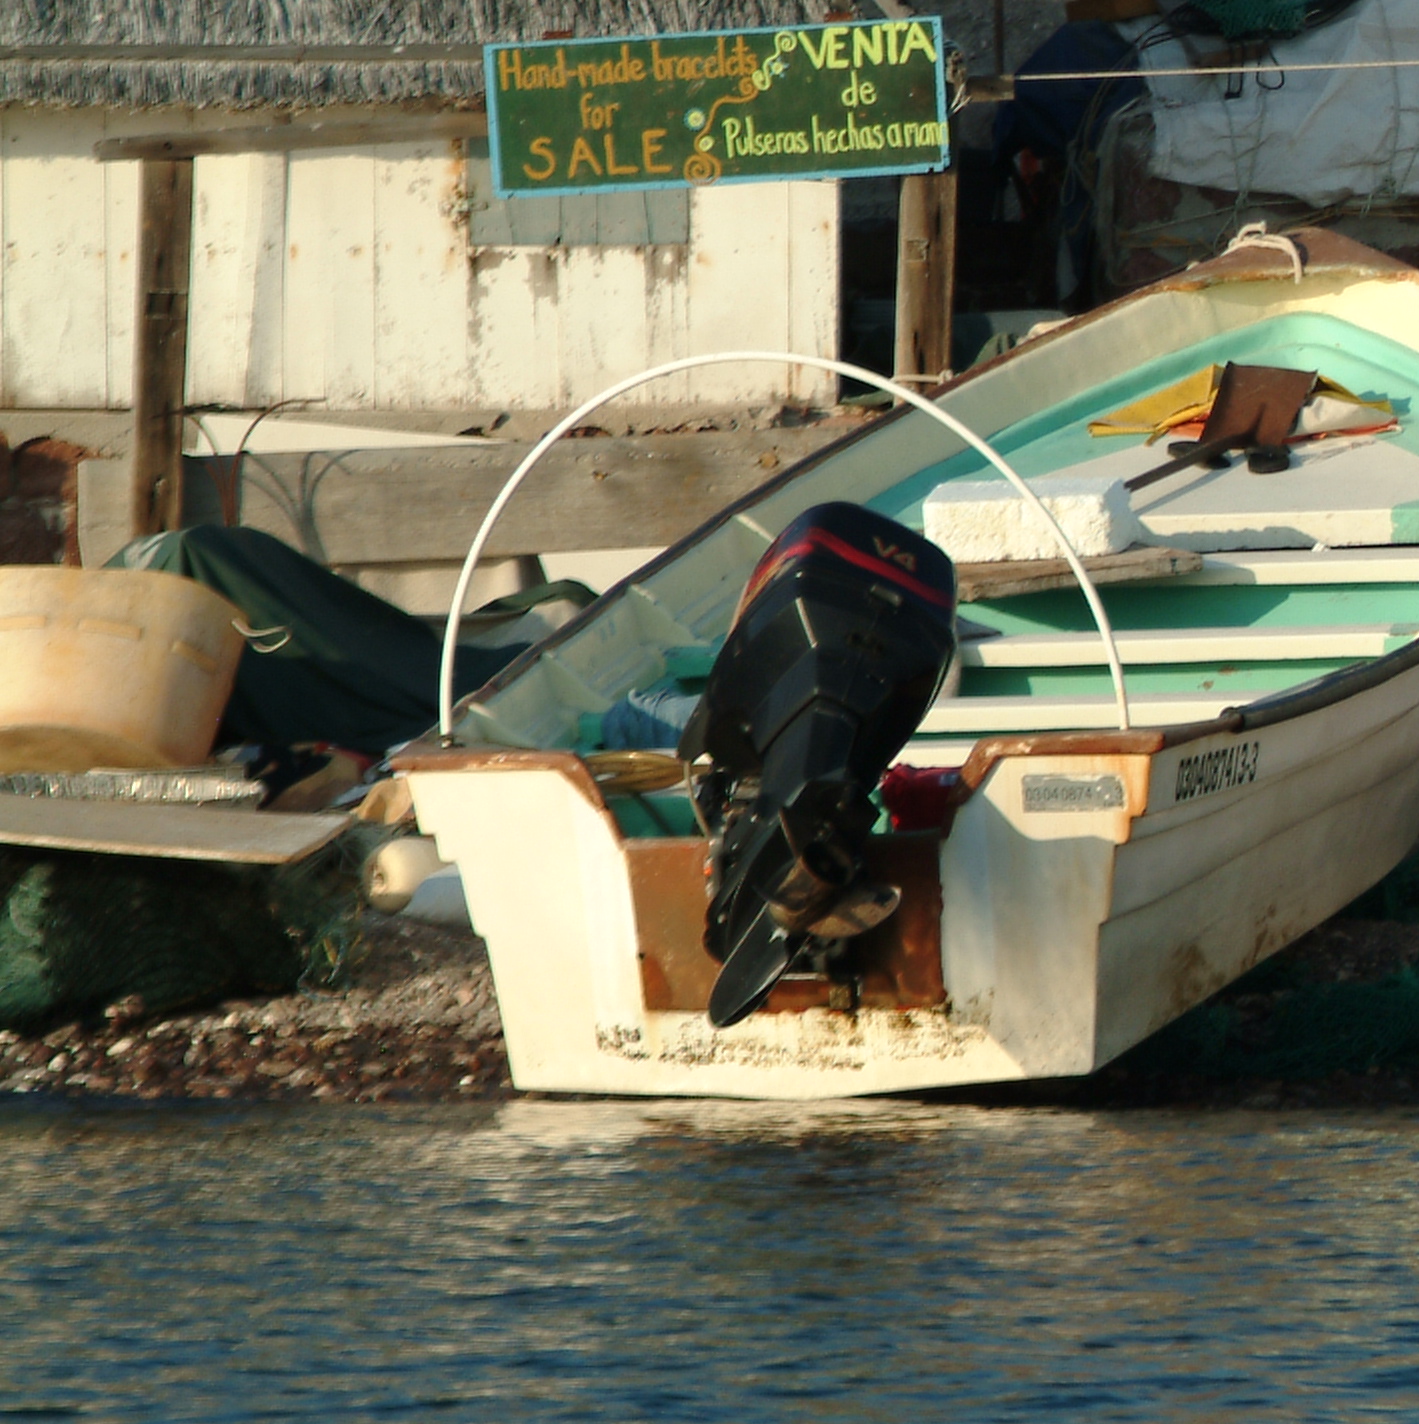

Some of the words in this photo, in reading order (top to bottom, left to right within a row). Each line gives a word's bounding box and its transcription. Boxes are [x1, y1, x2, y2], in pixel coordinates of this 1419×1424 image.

[499, 43, 647, 91] Hand-made
[652, 35, 758, 82] bracelets
[797, 21, 938, 70] VENTA
[580, 92, 620, 131] for
[841, 70, 878, 108] de
[523, 128, 673, 180] SALE
[721, 115, 812, 159] Pulseras
[811, 111, 885, 155] hechas
[886, 121, 902, 147] a
[872, 536, 918, 572] V4
